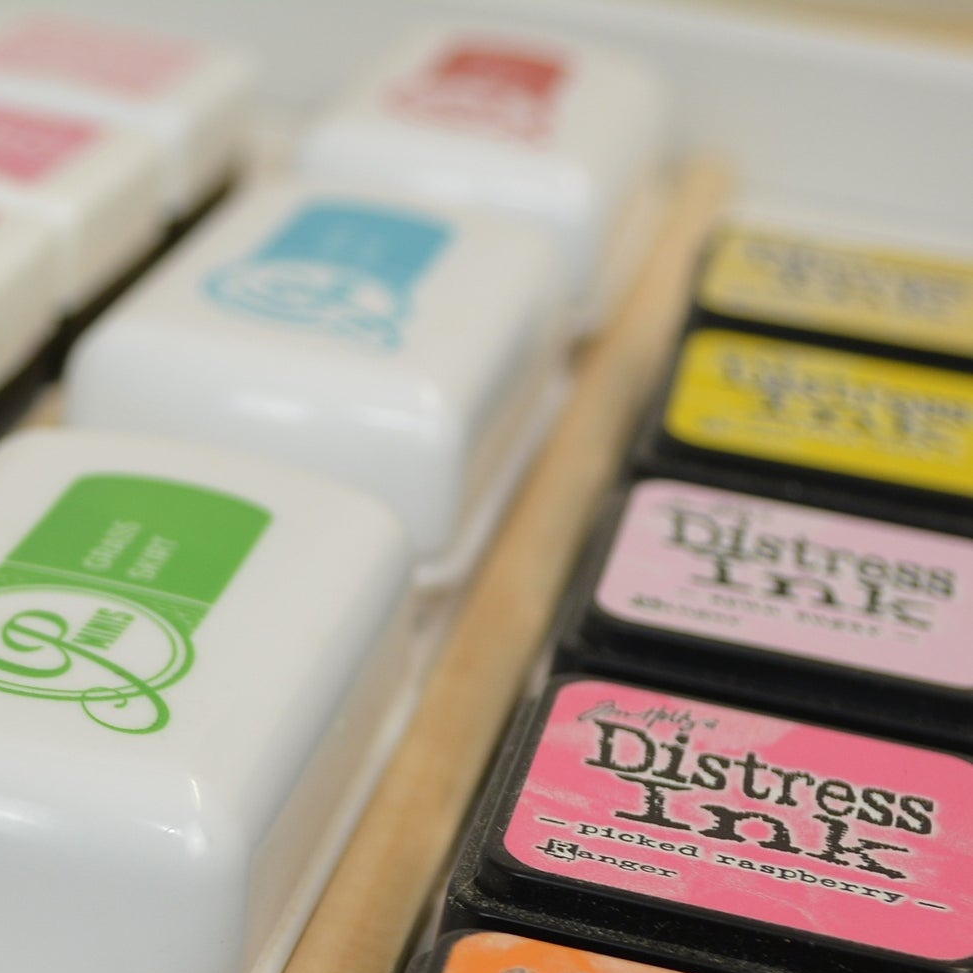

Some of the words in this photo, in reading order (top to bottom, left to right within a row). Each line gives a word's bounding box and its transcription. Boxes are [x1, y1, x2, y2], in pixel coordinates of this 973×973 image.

[82, 519, 144, 573] GRASS
[125, 533, 180, 583] SKIRT
[663, 507, 957, 600] Distress
[71, 607, 136, 650] MINIS
[689, 552, 935, 634] Ink
[584, 719, 935, 835] Distress
[536, 837, 679, 880] Ranger
[576, 821, 700, 860] picked
[714, 852, 907, 905] raspberry
[614, 772, 909, 881] Ink
